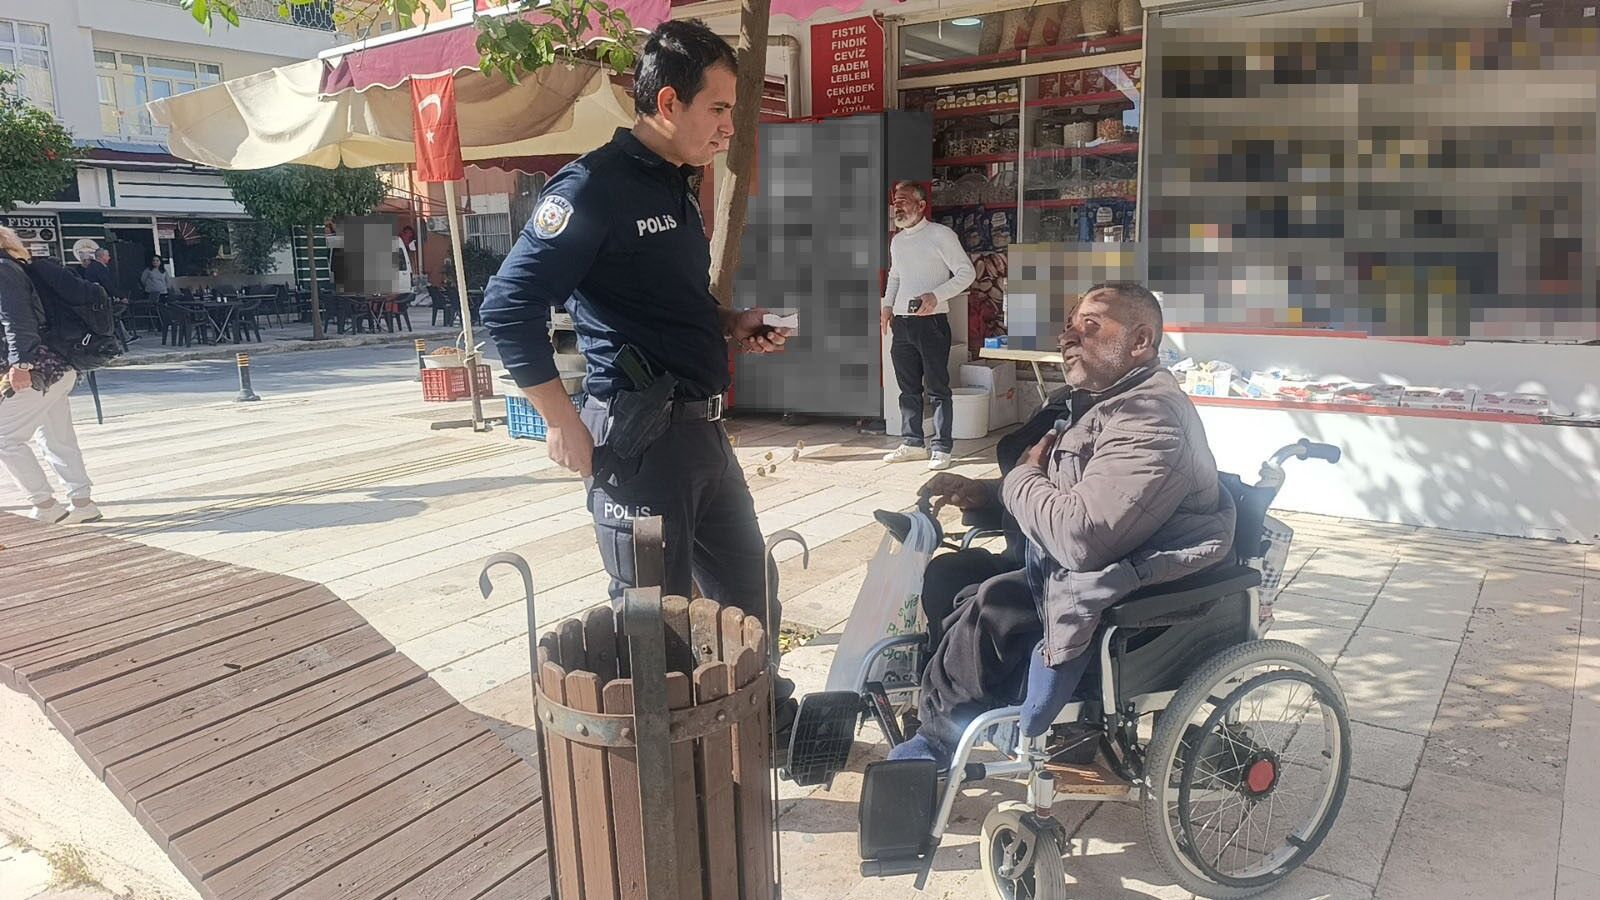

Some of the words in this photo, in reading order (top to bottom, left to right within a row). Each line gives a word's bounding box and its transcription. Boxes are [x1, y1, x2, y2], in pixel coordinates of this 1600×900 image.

[832, 25, 866, 38] FISTIK
[831, 37, 867, 50] FINDIK
[834, 48, 866, 61] CEVİZ
[832, 60, 869, 73] BADEM
[831, 69, 870, 83] LEBLEBİ
[826, 83, 875, 98] ÇEKİRDEK
[837, 95, 864, 105] KAJU
[7, 217, 55, 227] FISTIK
